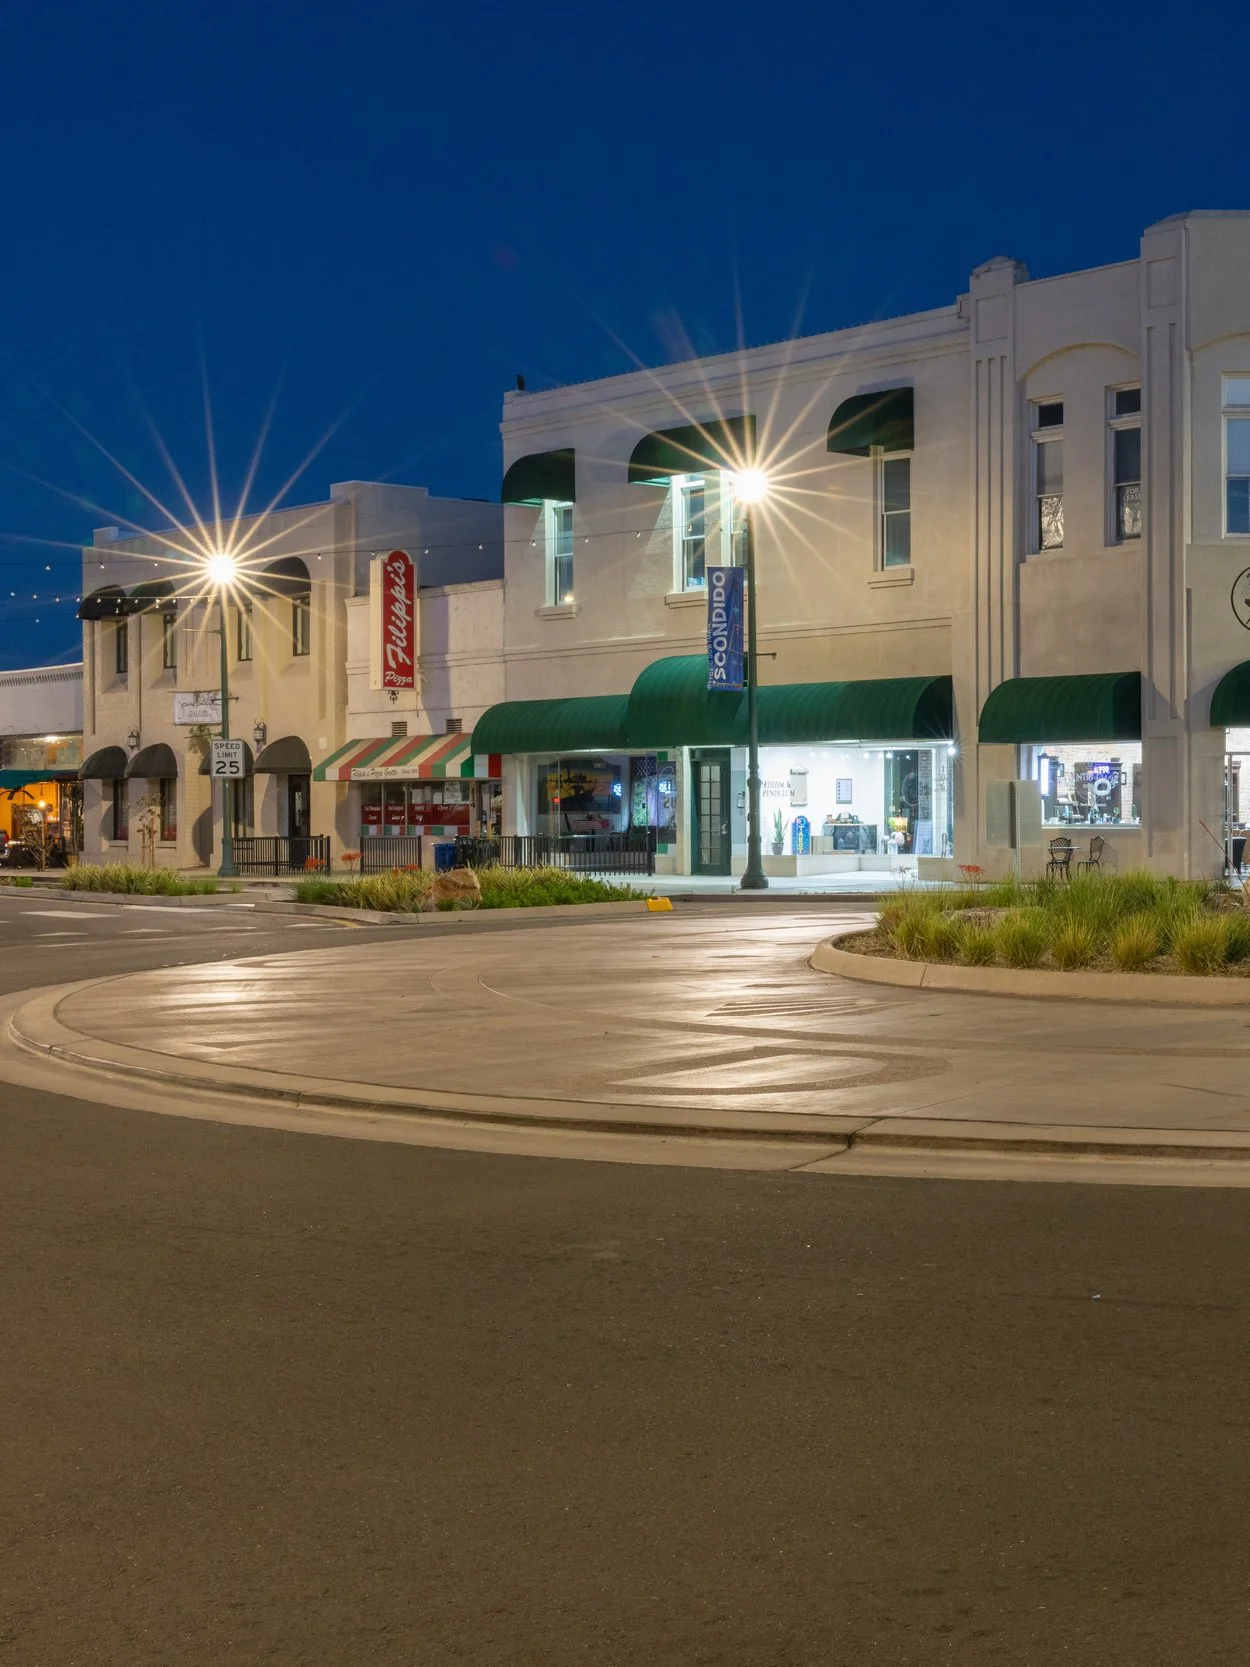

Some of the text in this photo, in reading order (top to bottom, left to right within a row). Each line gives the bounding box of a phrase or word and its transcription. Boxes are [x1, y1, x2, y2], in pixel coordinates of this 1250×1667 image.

[385, 559, 412, 669] Filippi's
[712, 571, 728, 681] SCONDIDO
[384, 671, 413, 686] Pizza
[214, 742, 241, 750] SPEED
[216, 751, 238, 759] LIMIT
[215, 760, 240, 775] 25
[762, 789, 796, 798] PENDULUM
